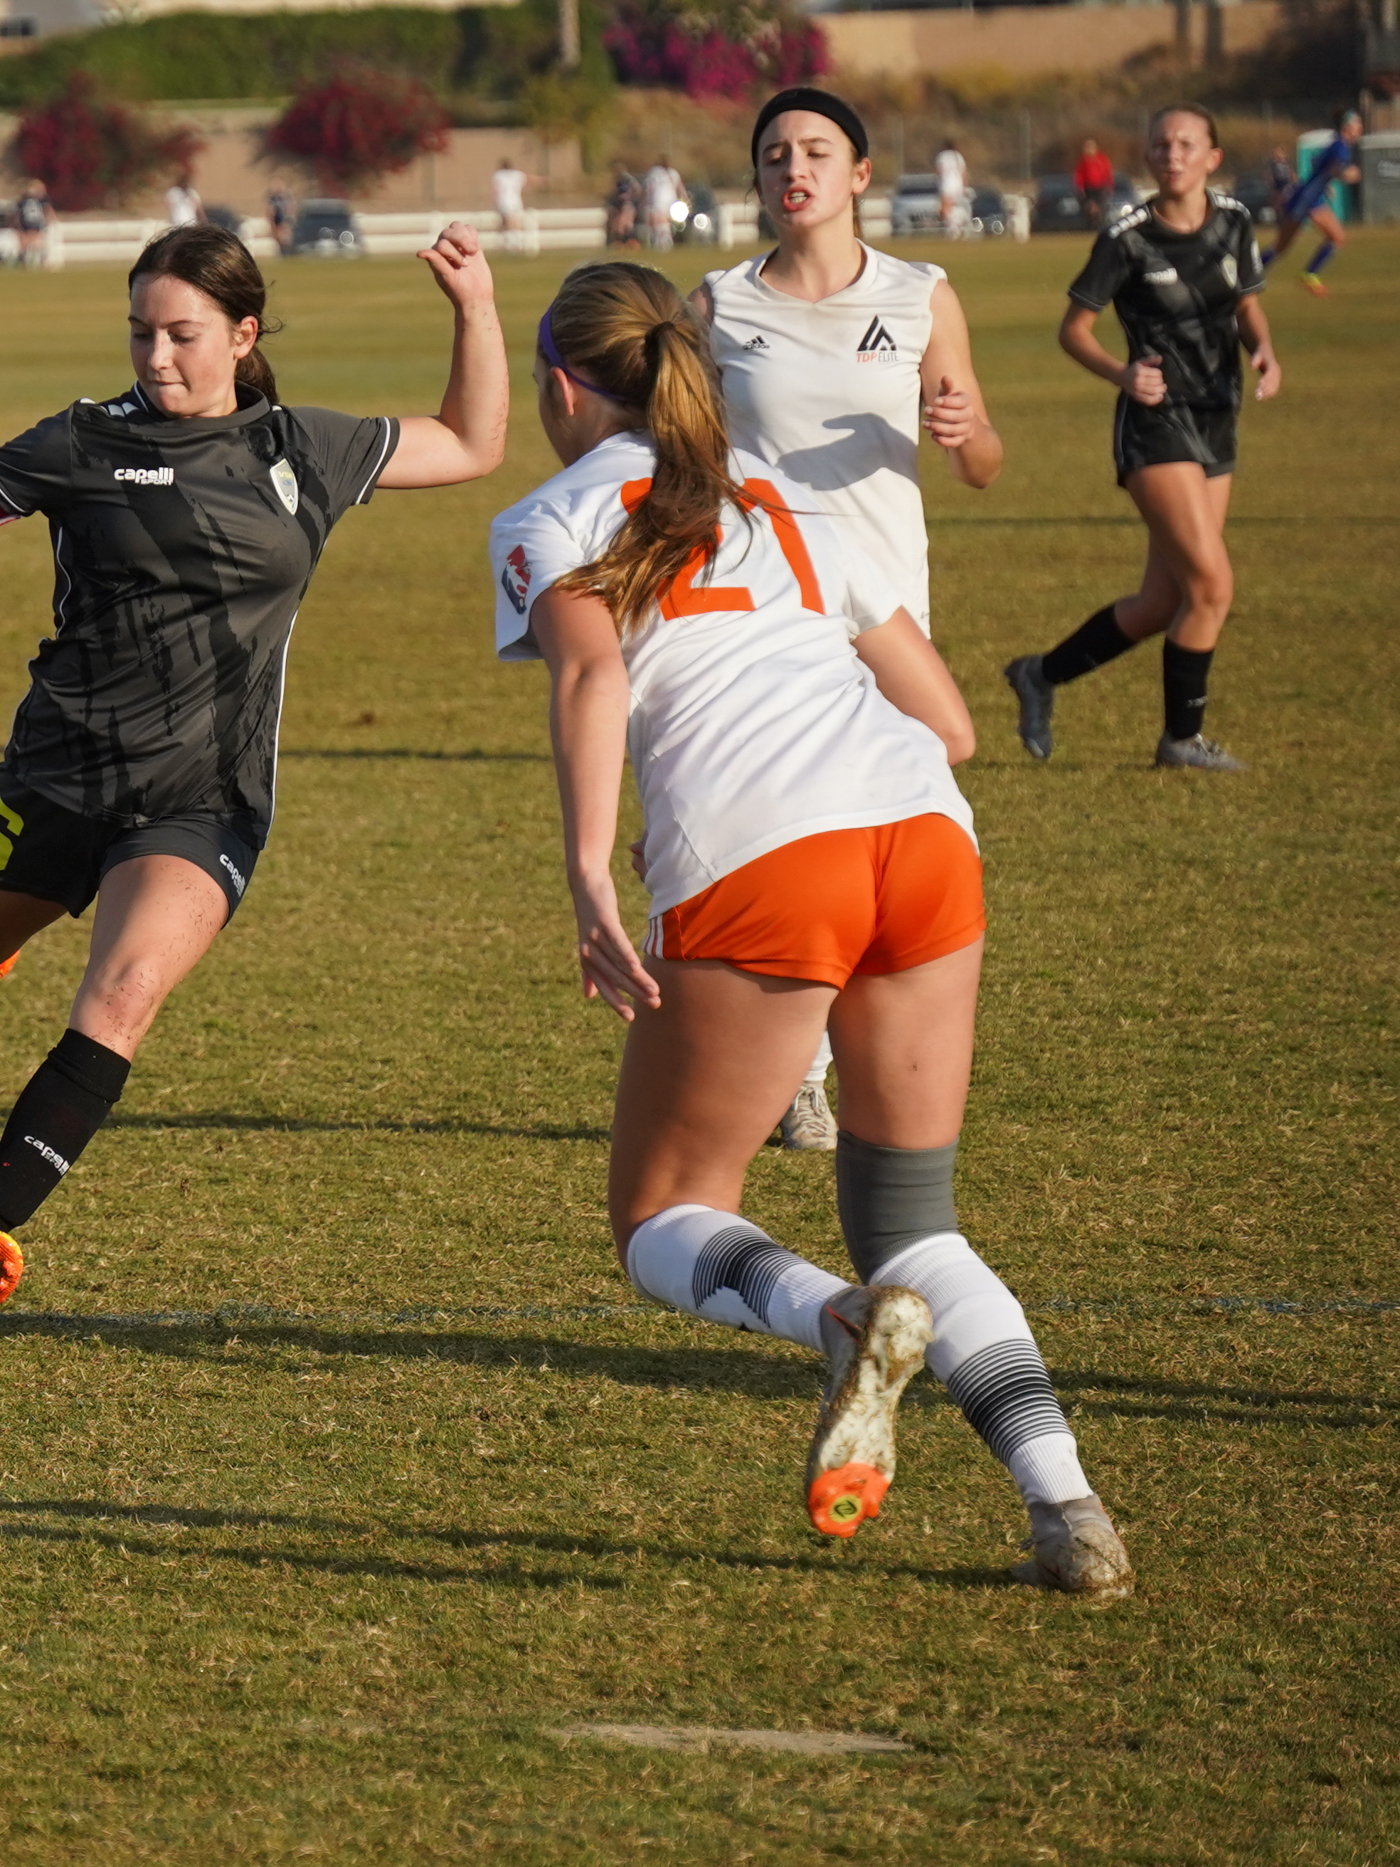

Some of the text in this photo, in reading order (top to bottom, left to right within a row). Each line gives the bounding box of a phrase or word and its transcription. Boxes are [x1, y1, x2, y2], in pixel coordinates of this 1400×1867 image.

[856, 352, 898, 363] TDP ELITE
[114, 467, 174, 484] capelli
